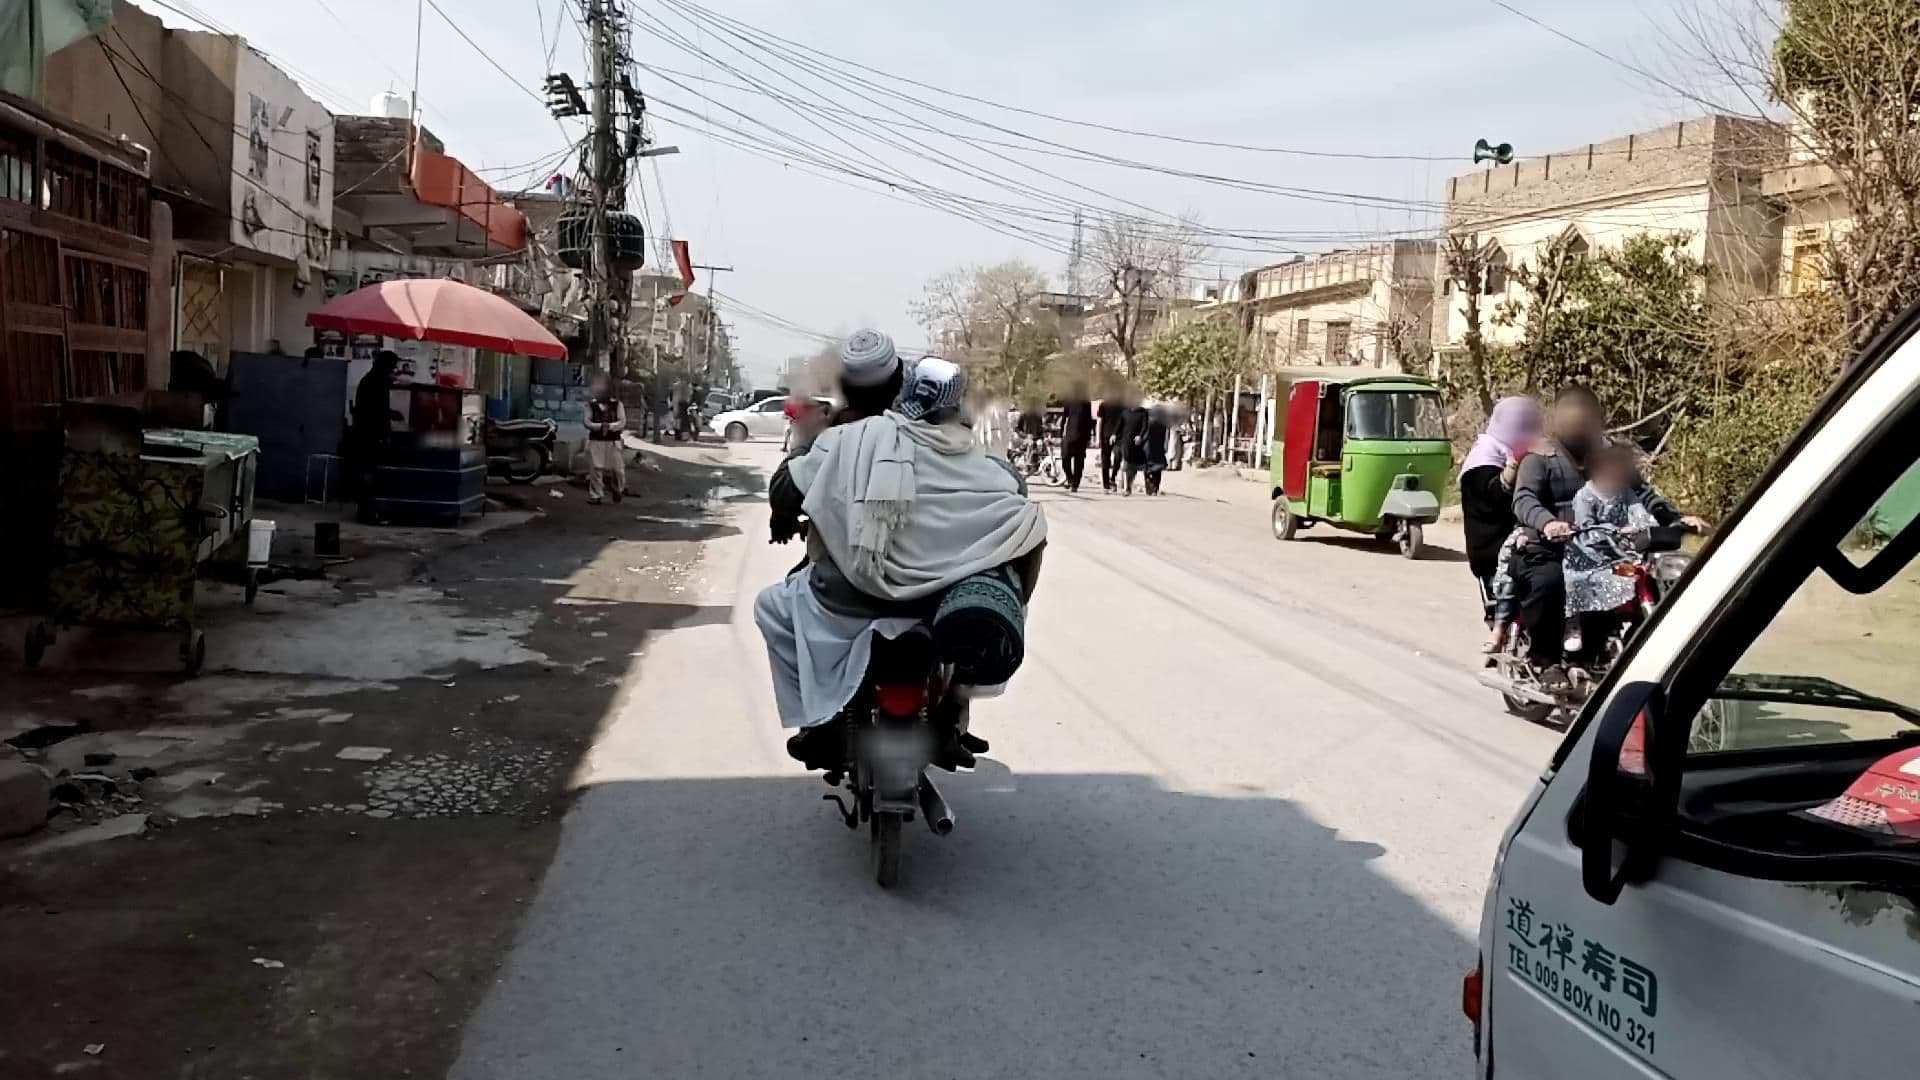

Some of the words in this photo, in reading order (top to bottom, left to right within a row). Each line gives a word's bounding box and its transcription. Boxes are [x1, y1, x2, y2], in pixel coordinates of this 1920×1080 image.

[1508, 943, 1531, 975] TEL
[1535, 961, 1558, 992] 009
[1563, 979, 1592, 1016] BOX
[1598, 1000, 1620, 1032] NO
[1626, 1018, 1655, 1054] 321
